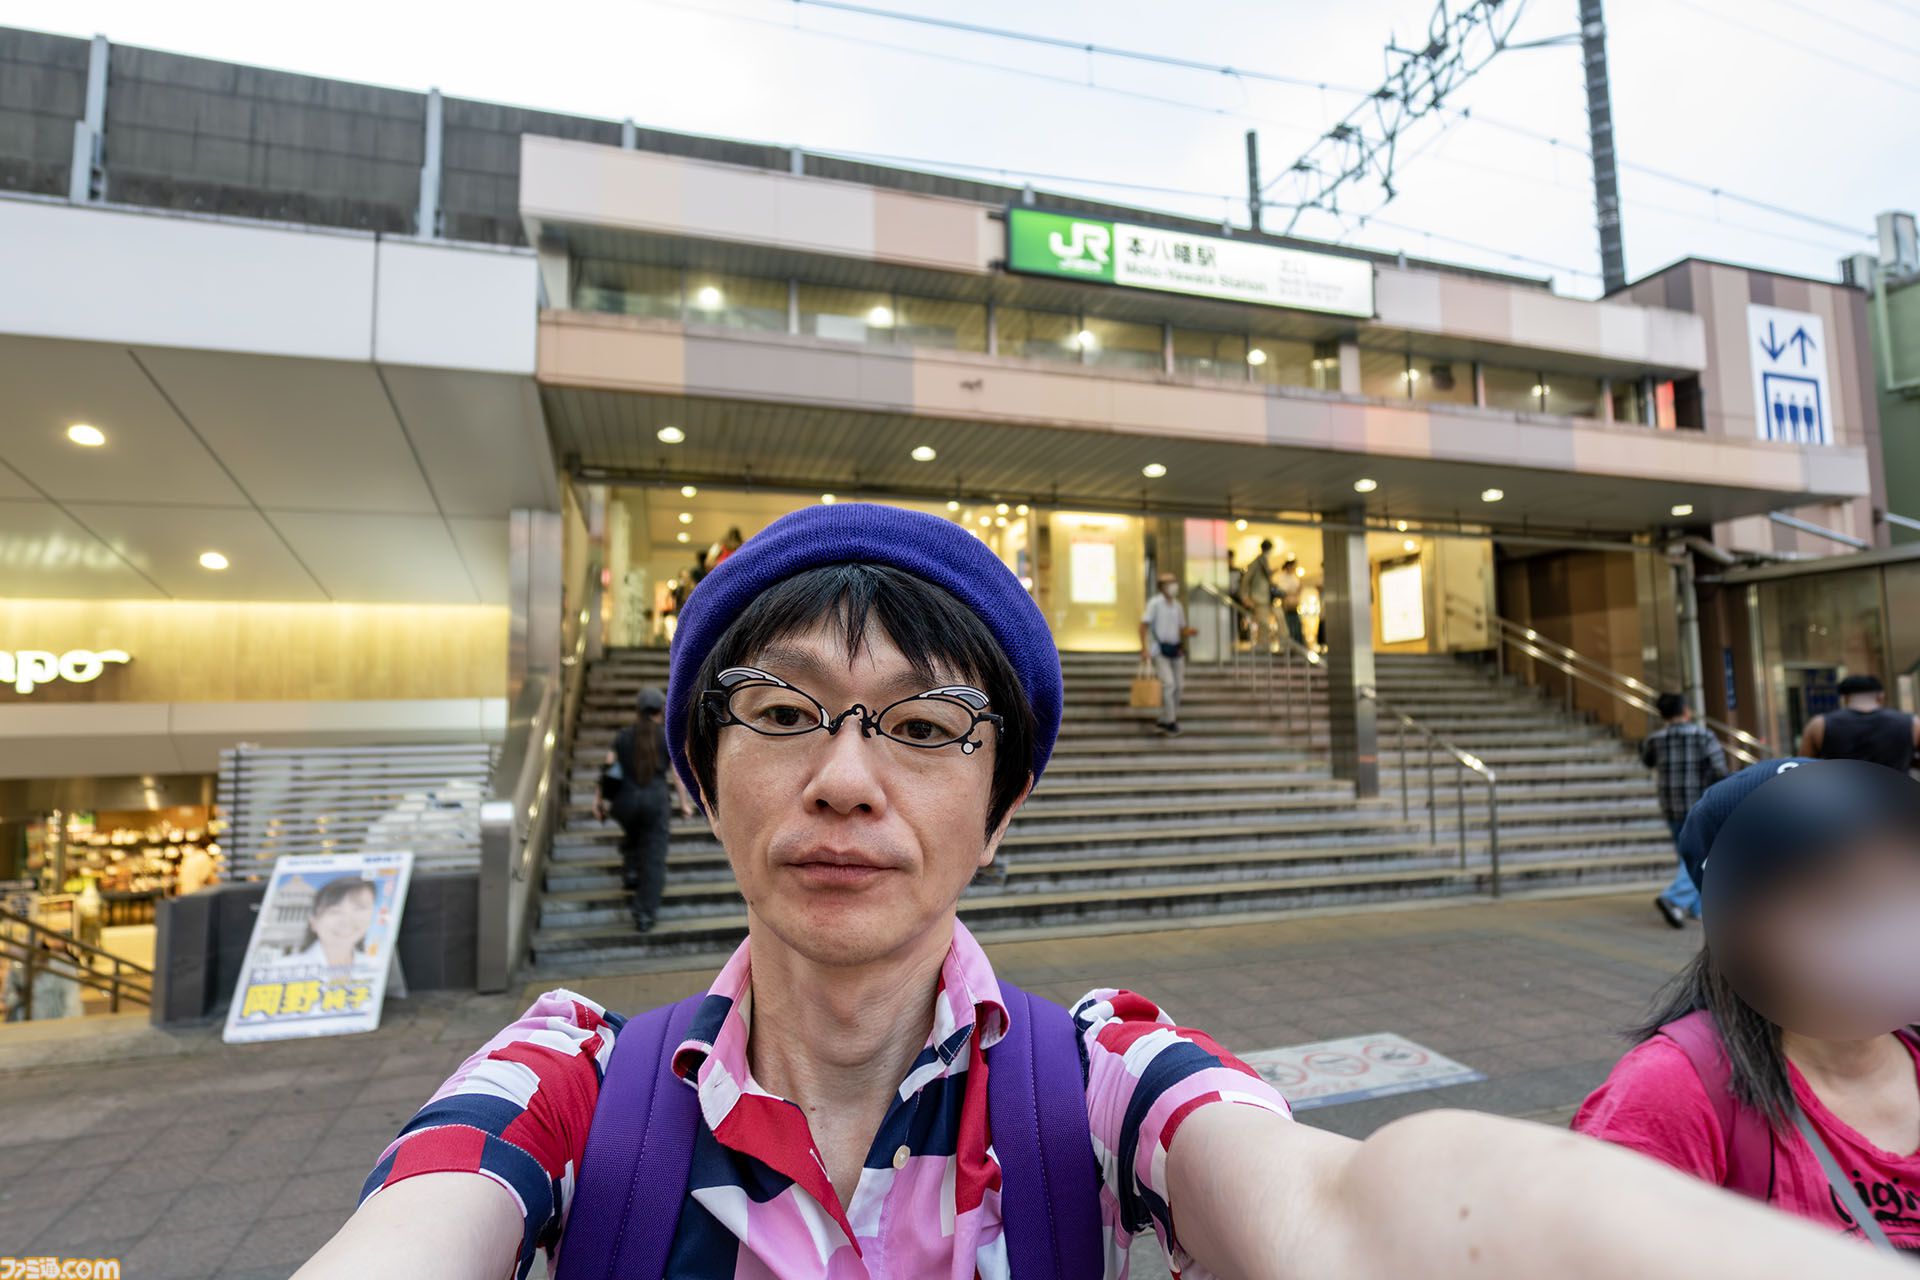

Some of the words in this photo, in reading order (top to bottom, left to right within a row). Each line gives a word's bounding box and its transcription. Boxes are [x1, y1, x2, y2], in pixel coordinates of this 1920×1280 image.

[1048, 222, 1110, 263] JR
[1127, 236, 1217, 268] 本八幡駅
[1219, 274, 1268, 292] Station
